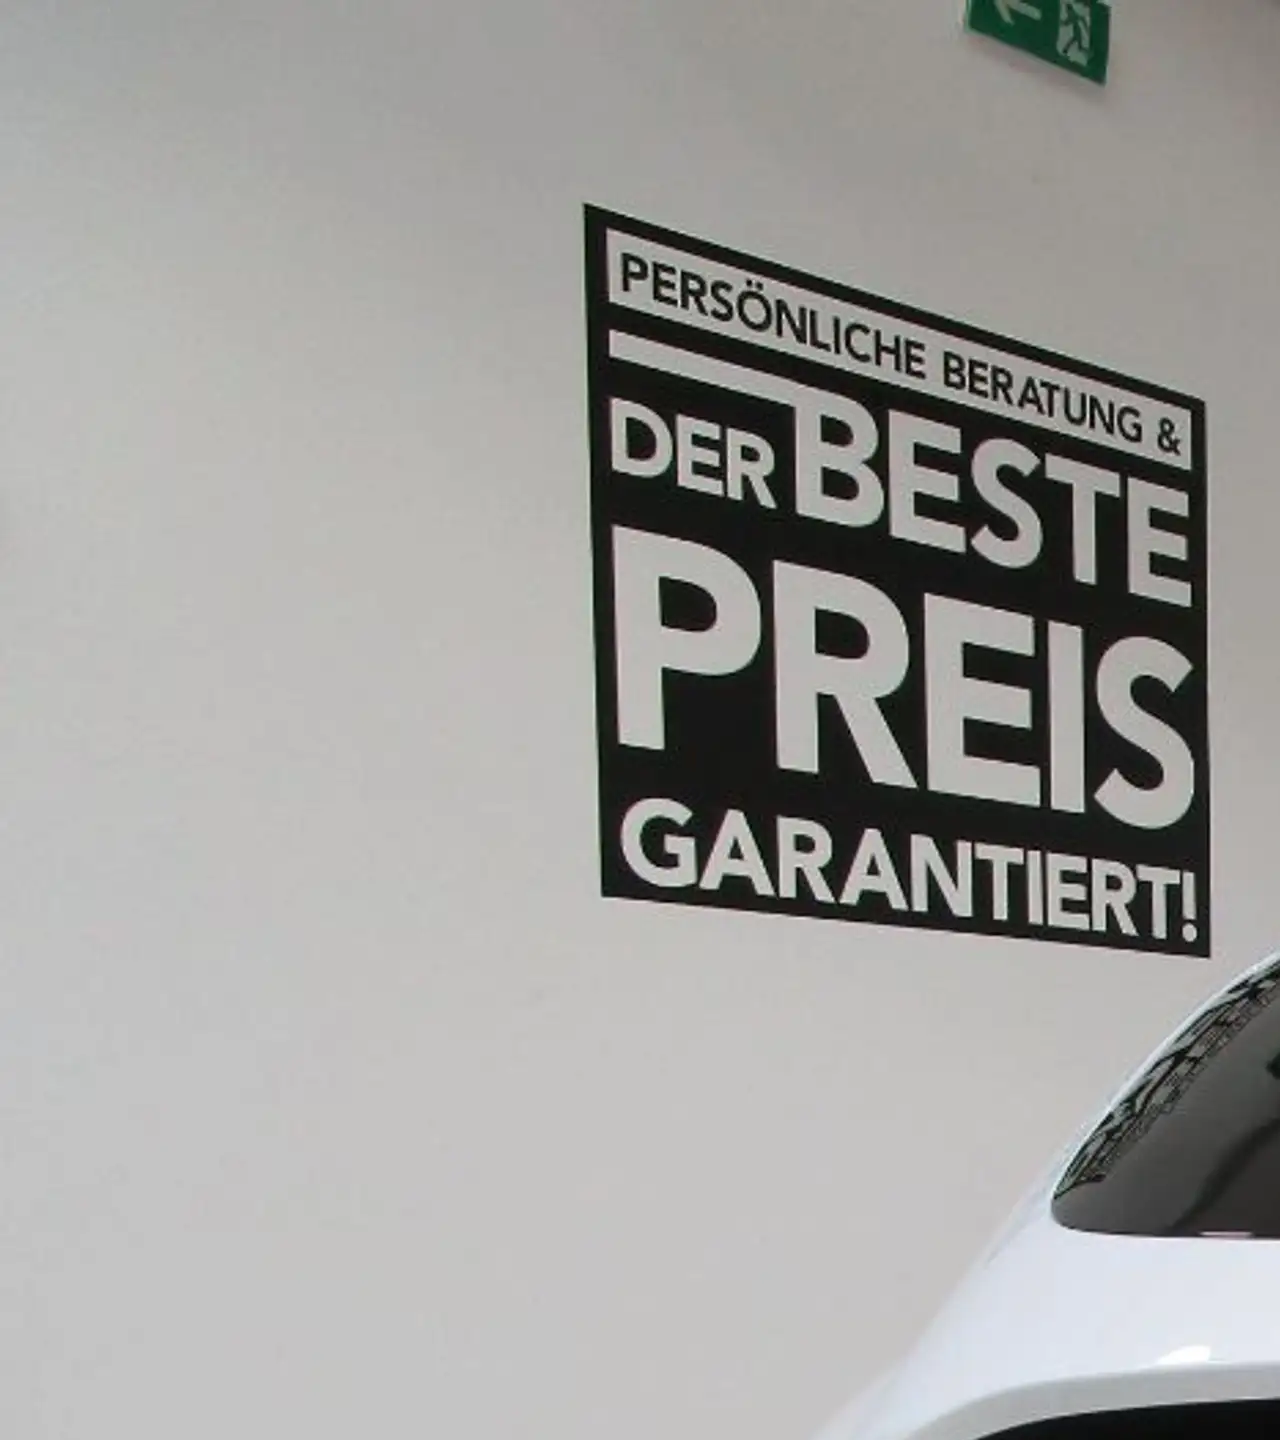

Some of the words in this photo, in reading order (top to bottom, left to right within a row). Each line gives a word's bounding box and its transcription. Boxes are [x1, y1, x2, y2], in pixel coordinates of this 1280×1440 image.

[620, 250, 926, 380] PERSÖNLICHE
[943, 353, 1142, 443] BERATUNG
[1157, 416, 1182, 456] &
[609, 397, 777, 509] DER
[795, 380, 1193, 607] BESTE
[611, 523, 1195, 830] PREIS
[620, 797, 1199, 943] GARANTIERT!
